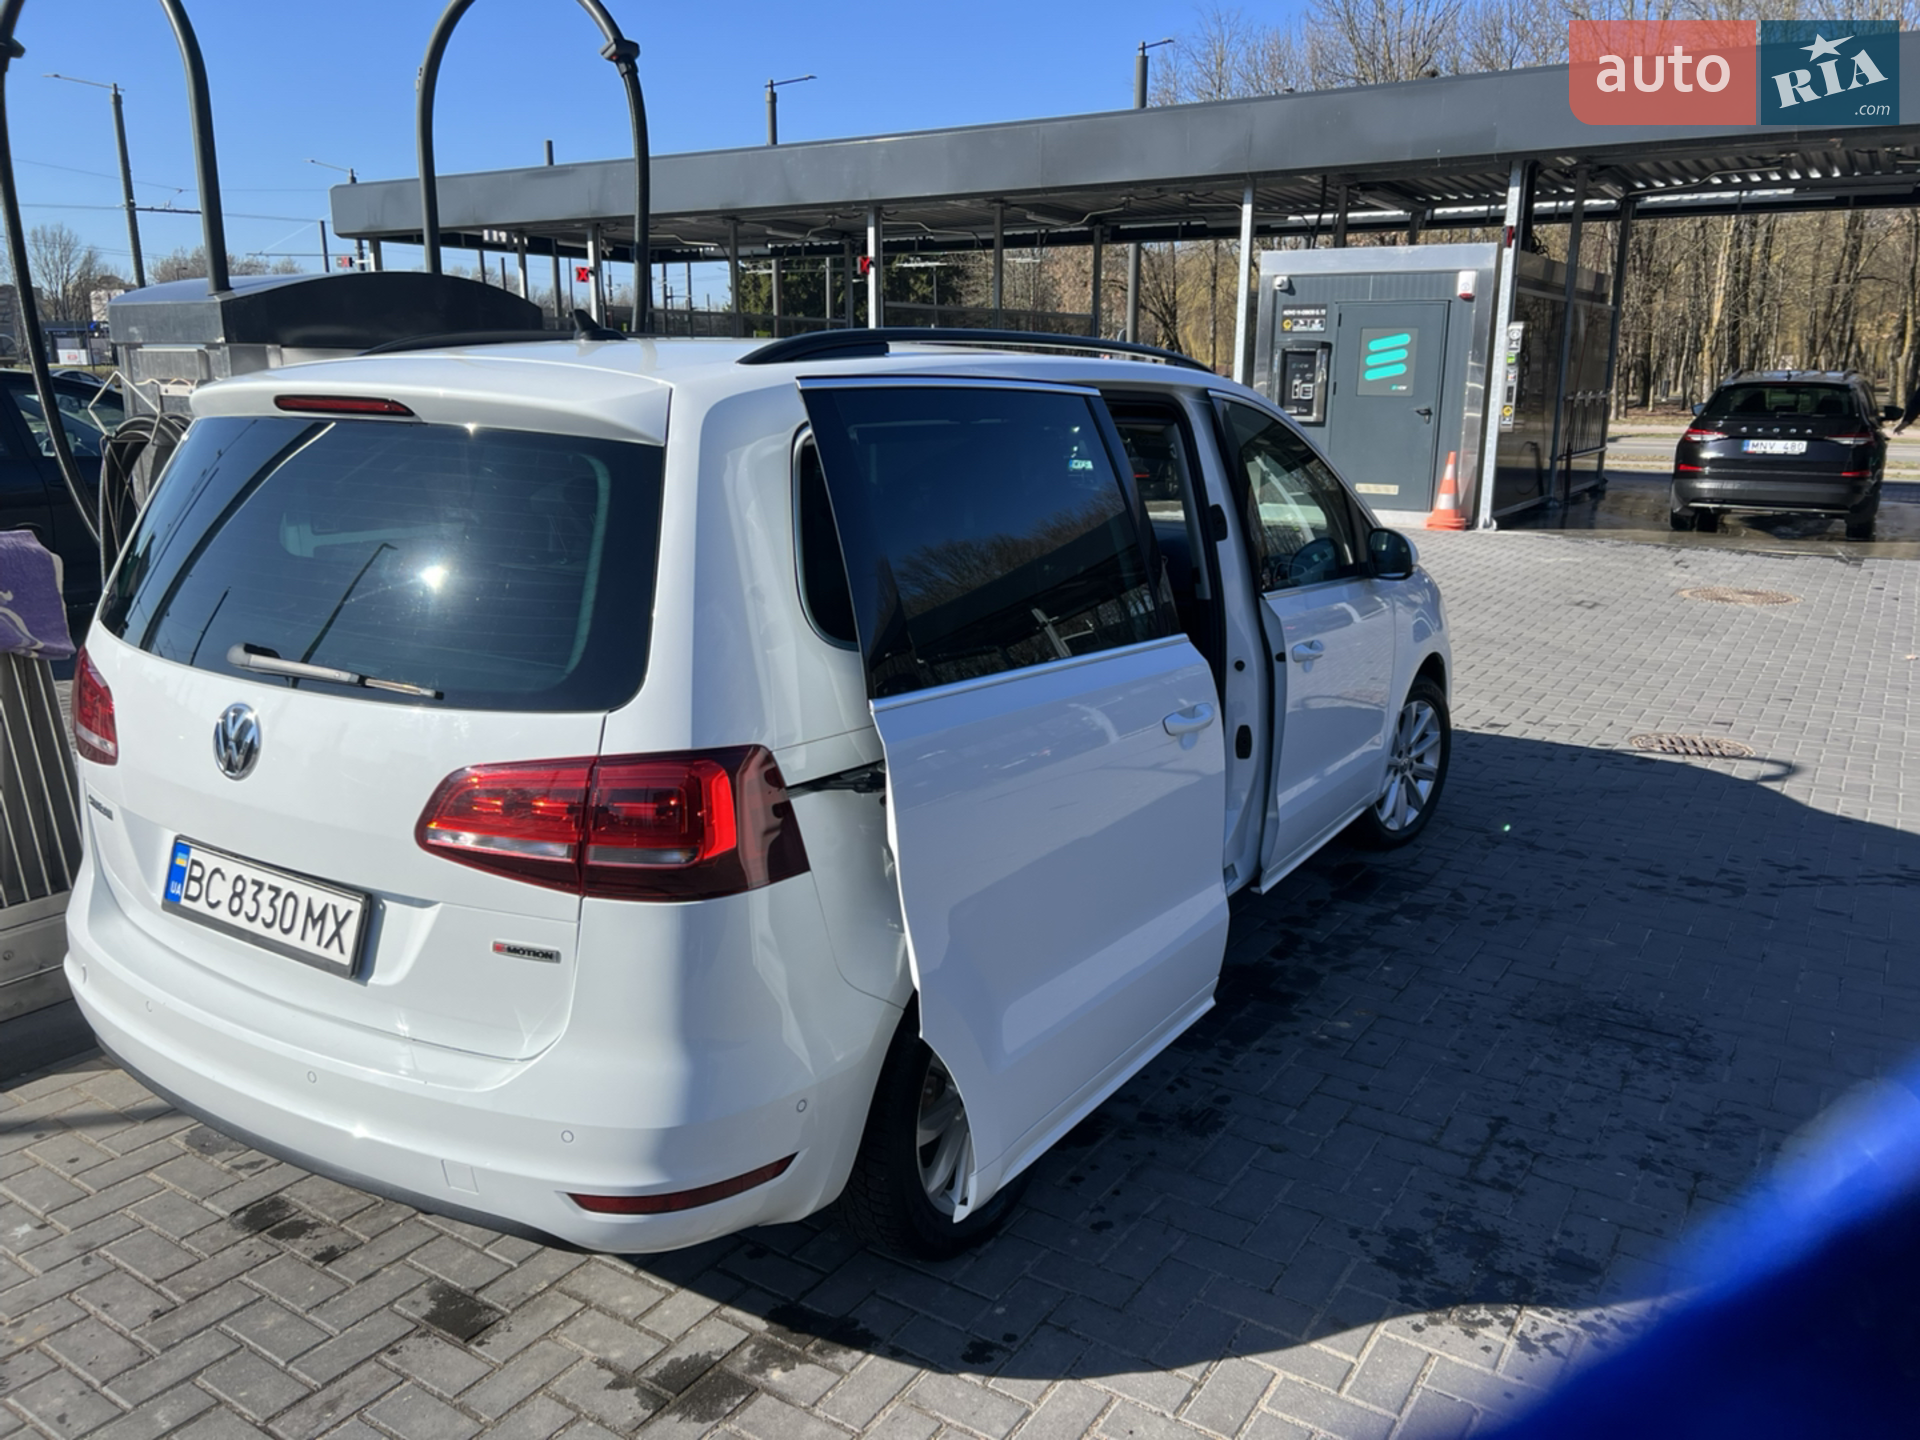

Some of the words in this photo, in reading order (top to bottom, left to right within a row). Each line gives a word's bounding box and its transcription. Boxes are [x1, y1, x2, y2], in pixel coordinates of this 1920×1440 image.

[1751, 442, 1776, 450] MNV
[169, 880, 182, 897] UA
[183, 858, 227, 909] BC
[227, 874, 300, 935] 8330
[299, 896, 354, 955] MX
